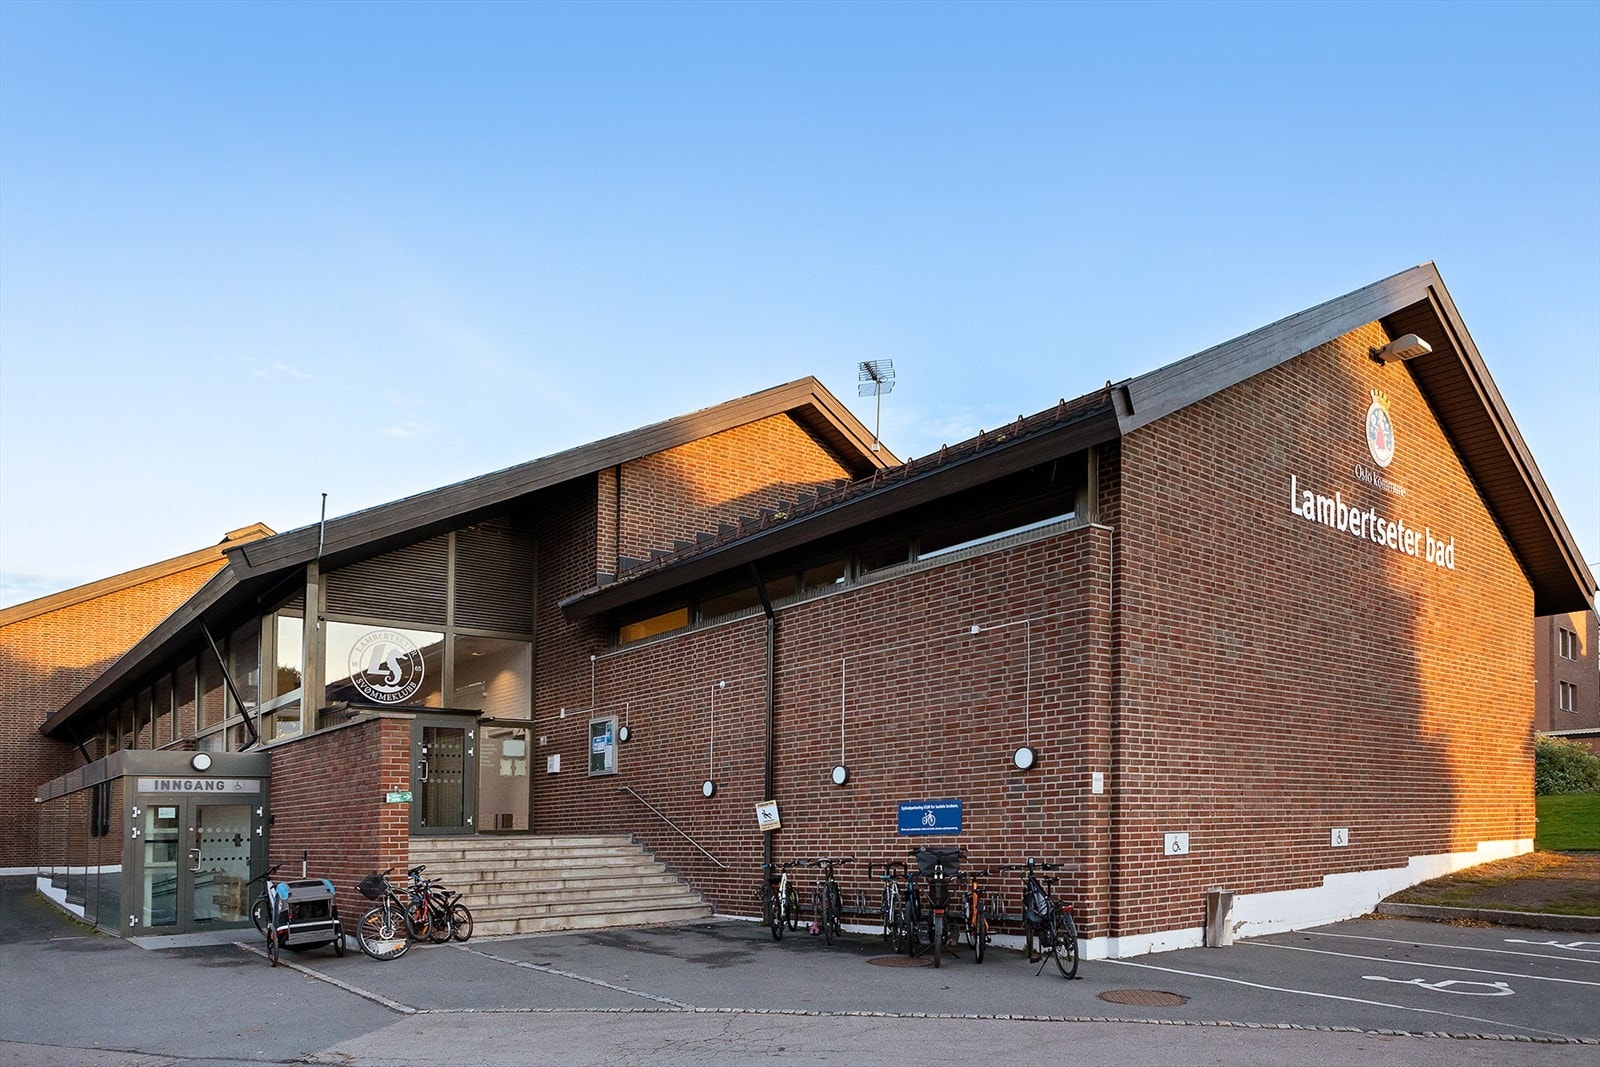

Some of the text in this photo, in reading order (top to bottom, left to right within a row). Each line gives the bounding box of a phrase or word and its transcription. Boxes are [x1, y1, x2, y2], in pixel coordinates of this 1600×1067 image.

[1355, 463, 1407, 498] Oslo kommune
[1290, 474, 1455, 570] Lambertseter bad
[356, 633, 418, 657] LAMBERTSETER
[356, 678, 417, 701] SVØMMEKLUBB
[154, 780, 225, 791] INNGANG
